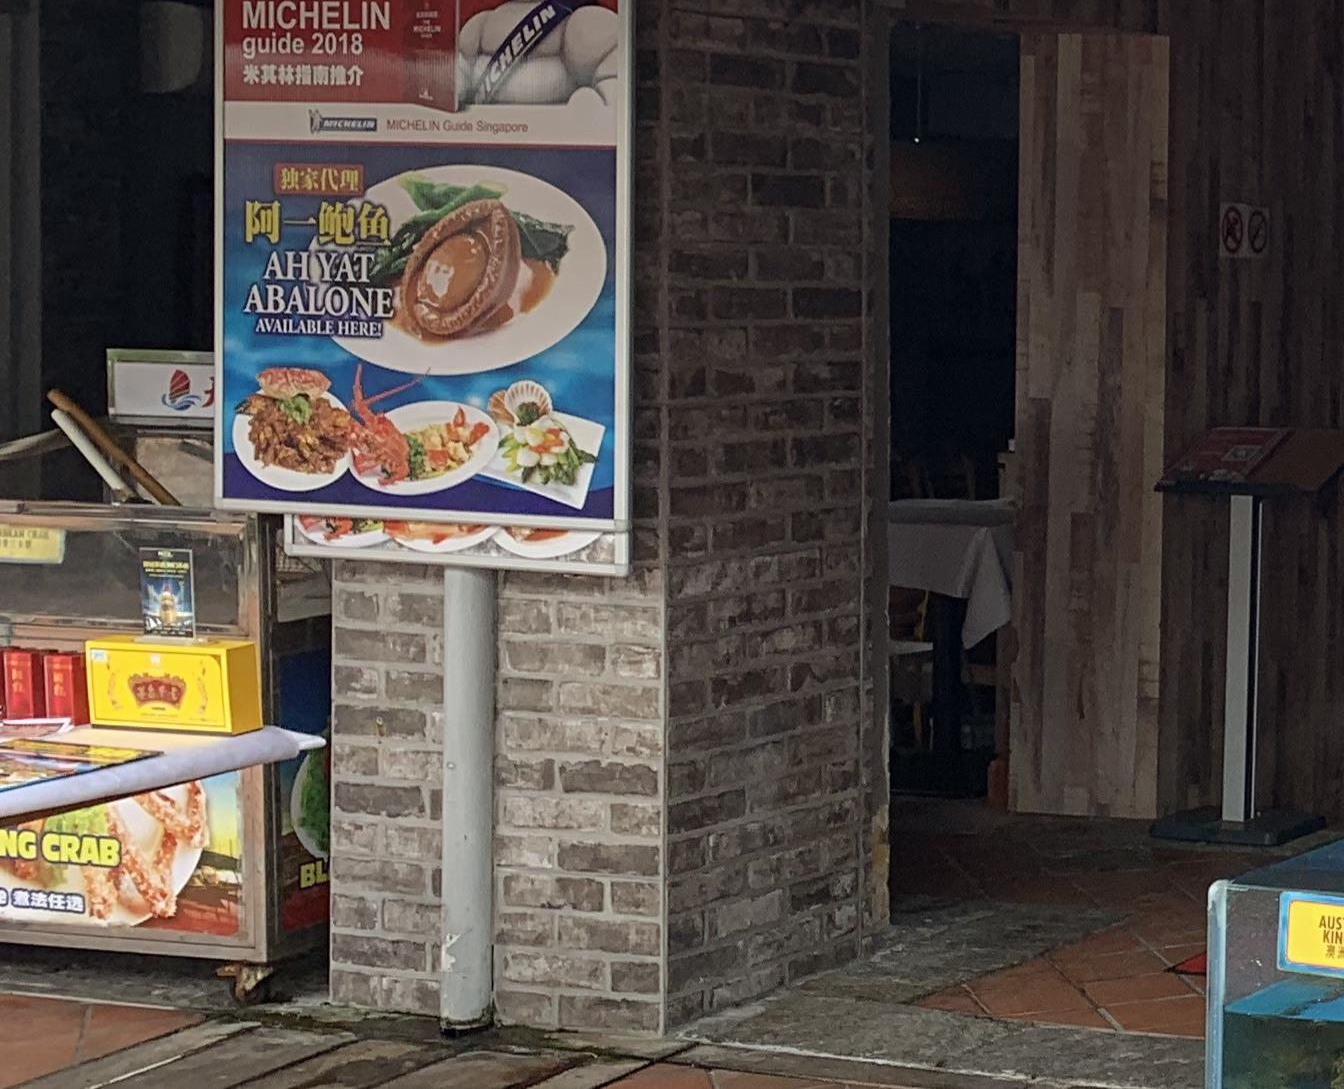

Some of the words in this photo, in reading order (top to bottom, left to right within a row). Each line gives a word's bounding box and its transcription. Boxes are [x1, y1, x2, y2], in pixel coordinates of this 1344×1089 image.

[242, 0, 390, 30] MICHELIN
[242, 31, 304, 59] guide
[312, 32, 363, 55] 2018
[243, 64, 363, 86] 米其林指南推介
[323, 119, 376, 129] MICHELIN
[386, 119, 440, 131] MICHELIN
[443, 119, 472, 132] Guide
[477, 120, 528, 134] Singapore
[245, 200, 391, 245] 阿一鲍鱼
[264, 251, 309, 280] AH
[316, 251, 375, 283] YAT
[243, 284, 394, 317] ABALONE
[256, 318, 334, 335] AVAILABLE
[338, 320, 382, 336] HERE!
[42, 832, 121, 866] CRAB
